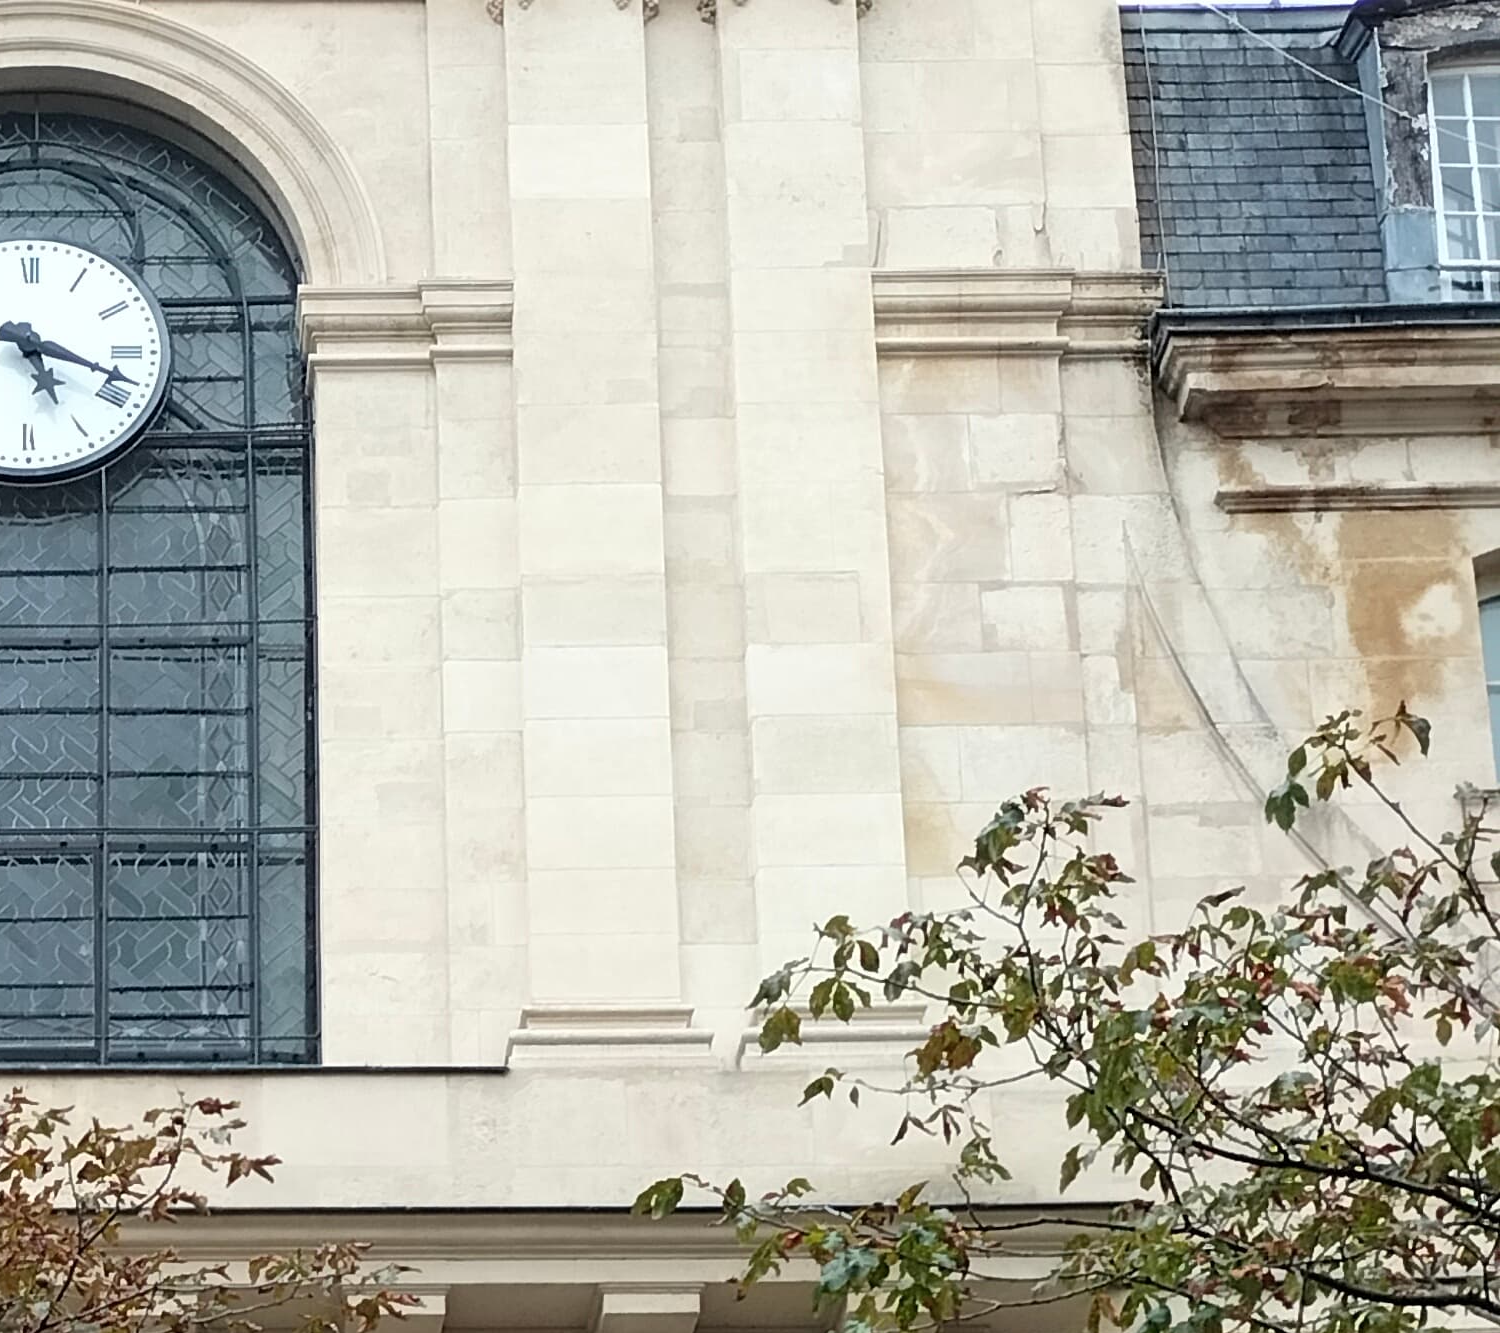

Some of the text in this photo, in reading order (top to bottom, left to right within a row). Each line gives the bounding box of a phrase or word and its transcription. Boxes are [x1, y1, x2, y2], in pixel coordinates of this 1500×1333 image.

[69, 267, 88, 293] I
[97, 299, 130, 321] II
[110, 345, 143, 360] III
